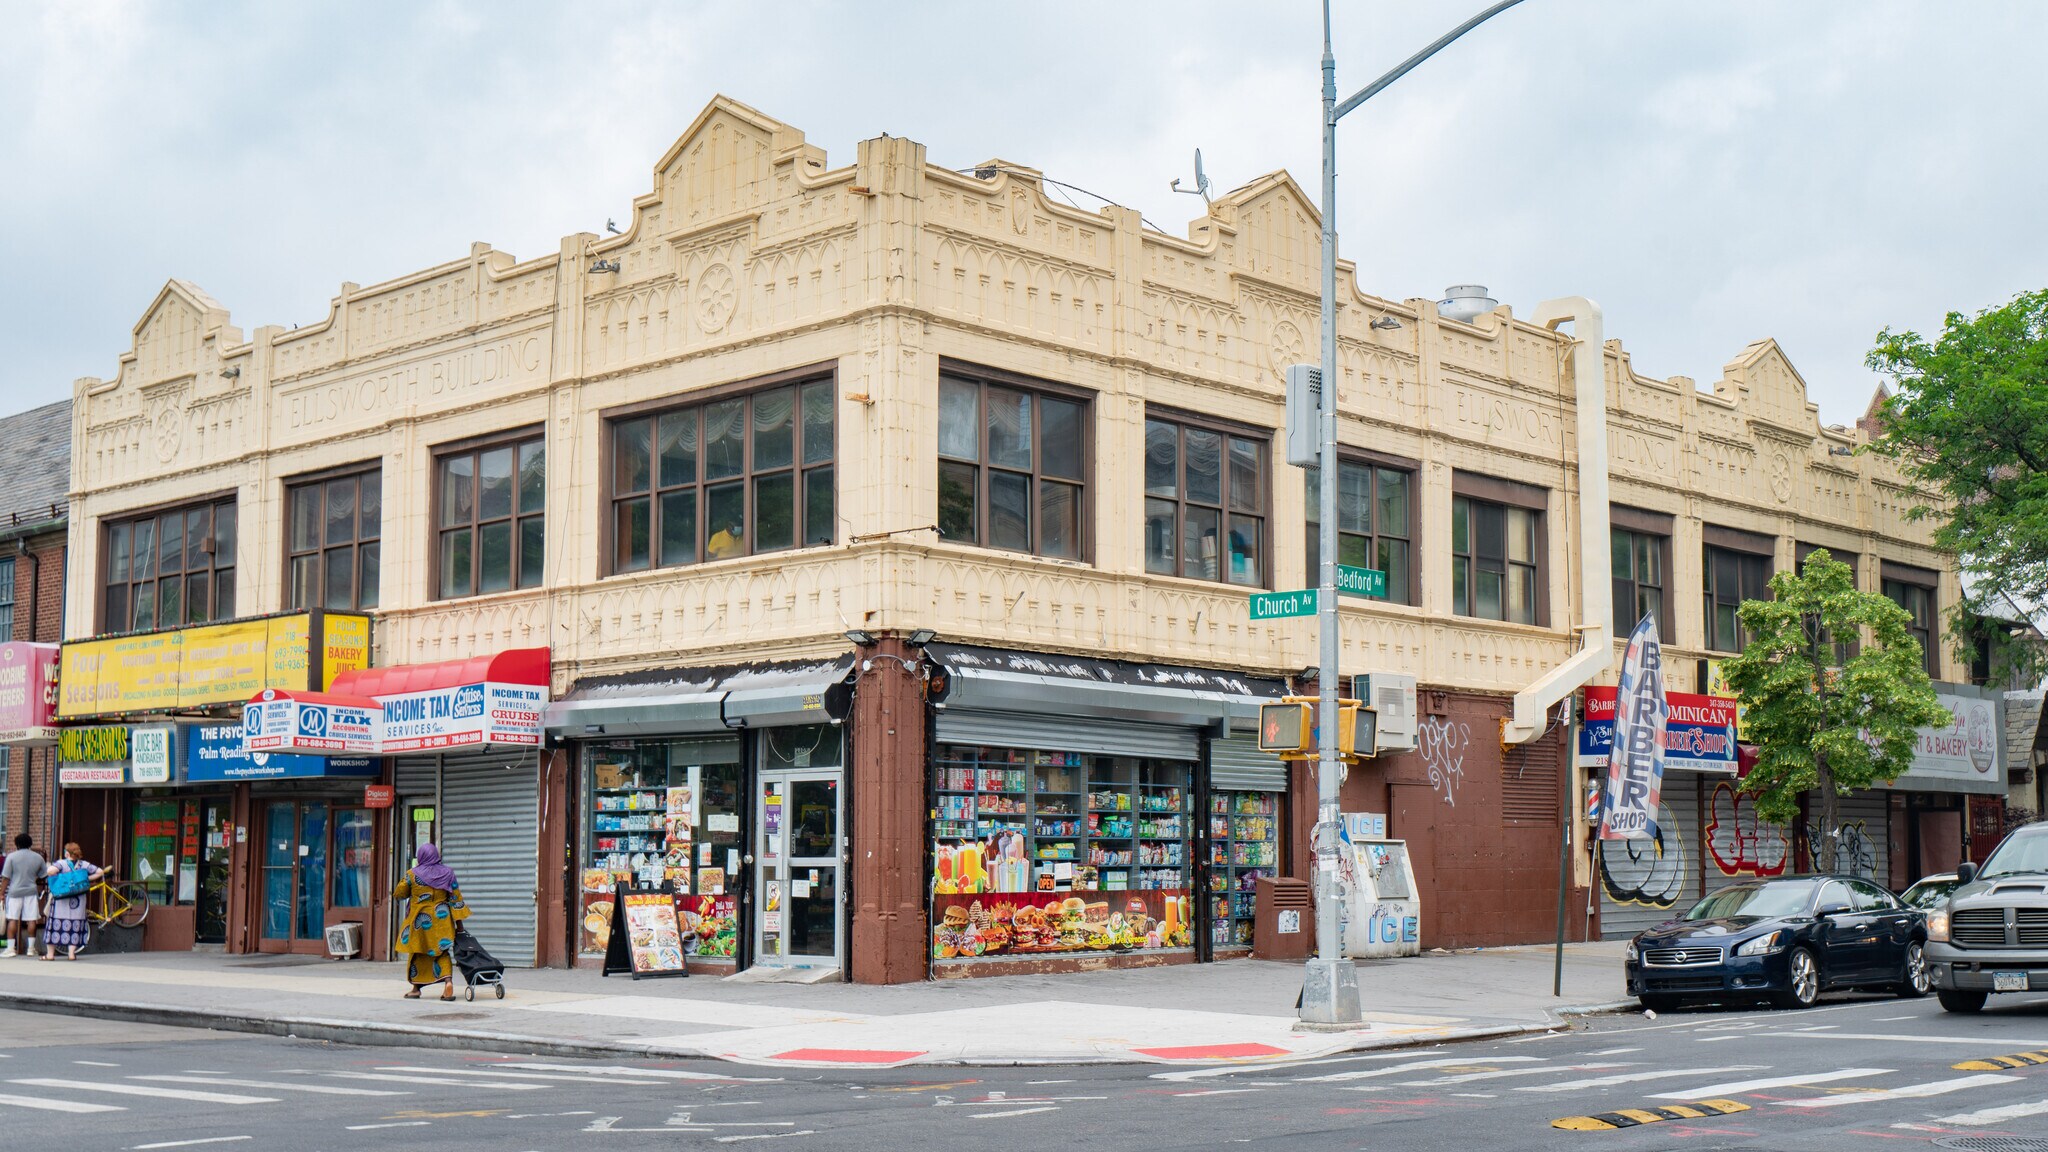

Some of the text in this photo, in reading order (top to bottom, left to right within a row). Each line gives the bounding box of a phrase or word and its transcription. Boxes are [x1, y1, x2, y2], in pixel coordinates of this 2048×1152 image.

[290, 336, 540, 430] ELLSWORTH BUILDING
[1456, 390, 1577, 450] ELLSWORTH
[1338, 568, 1382, 592] Bedford Av
[1257, 593, 1312, 616] Church Av
[336, 620, 357, 631] FOUR
[329, 634, 363, 645] SEASONS
[328, 646, 363, 660] BAKERY
[274, 658, 305, 672] 941-9363
[0, 665, 26, 686] ODBINE
[66, 652, 120, 704] Four Seasons
[492, 688, 540, 701] INCOME TAX
[267, 701, 292, 711] INCOME TAX
[336, 708, 365, 716] INCOME
[383, 694, 451, 724] INCOME TAX
[498, 700, 527, 710] SERVICES
[267, 710, 287, 720] SERVICES
[330, 713, 372, 726] TAX
[491, 709, 540, 722] CRUISE
[332, 725, 369, 733] ACCOUNTING
[387, 723, 431, 738] SERVICES
[496, 719, 537, 728] SERVICES
[1619, 640, 1661, 811] BARBER
[200, 726, 243, 740] THE PSYC
[328, 731, 373, 741] CRUISE SERVICES
[58, 726, 128, 762] FOUR SEASONS
[135, 733, 163, 752] JUICE BAR
[404, 738, 421, 749] SERVICES
[1926, 735, 1933, 754] &
[1935, 736, 1968, 757] BAKERY
[199, 747, 219, 760] Palm
[61, 770, 121, 780] VEGETARIAN RESTAURANT
[367, 790, 389, 799] Digicel
[1352, 817, 1383, 835] ICE
[1611, 811, 1647, 832] SHOP
[1039, 878, 1055, 889] OPEN
[1368, 915, 1418, 944] ICE
